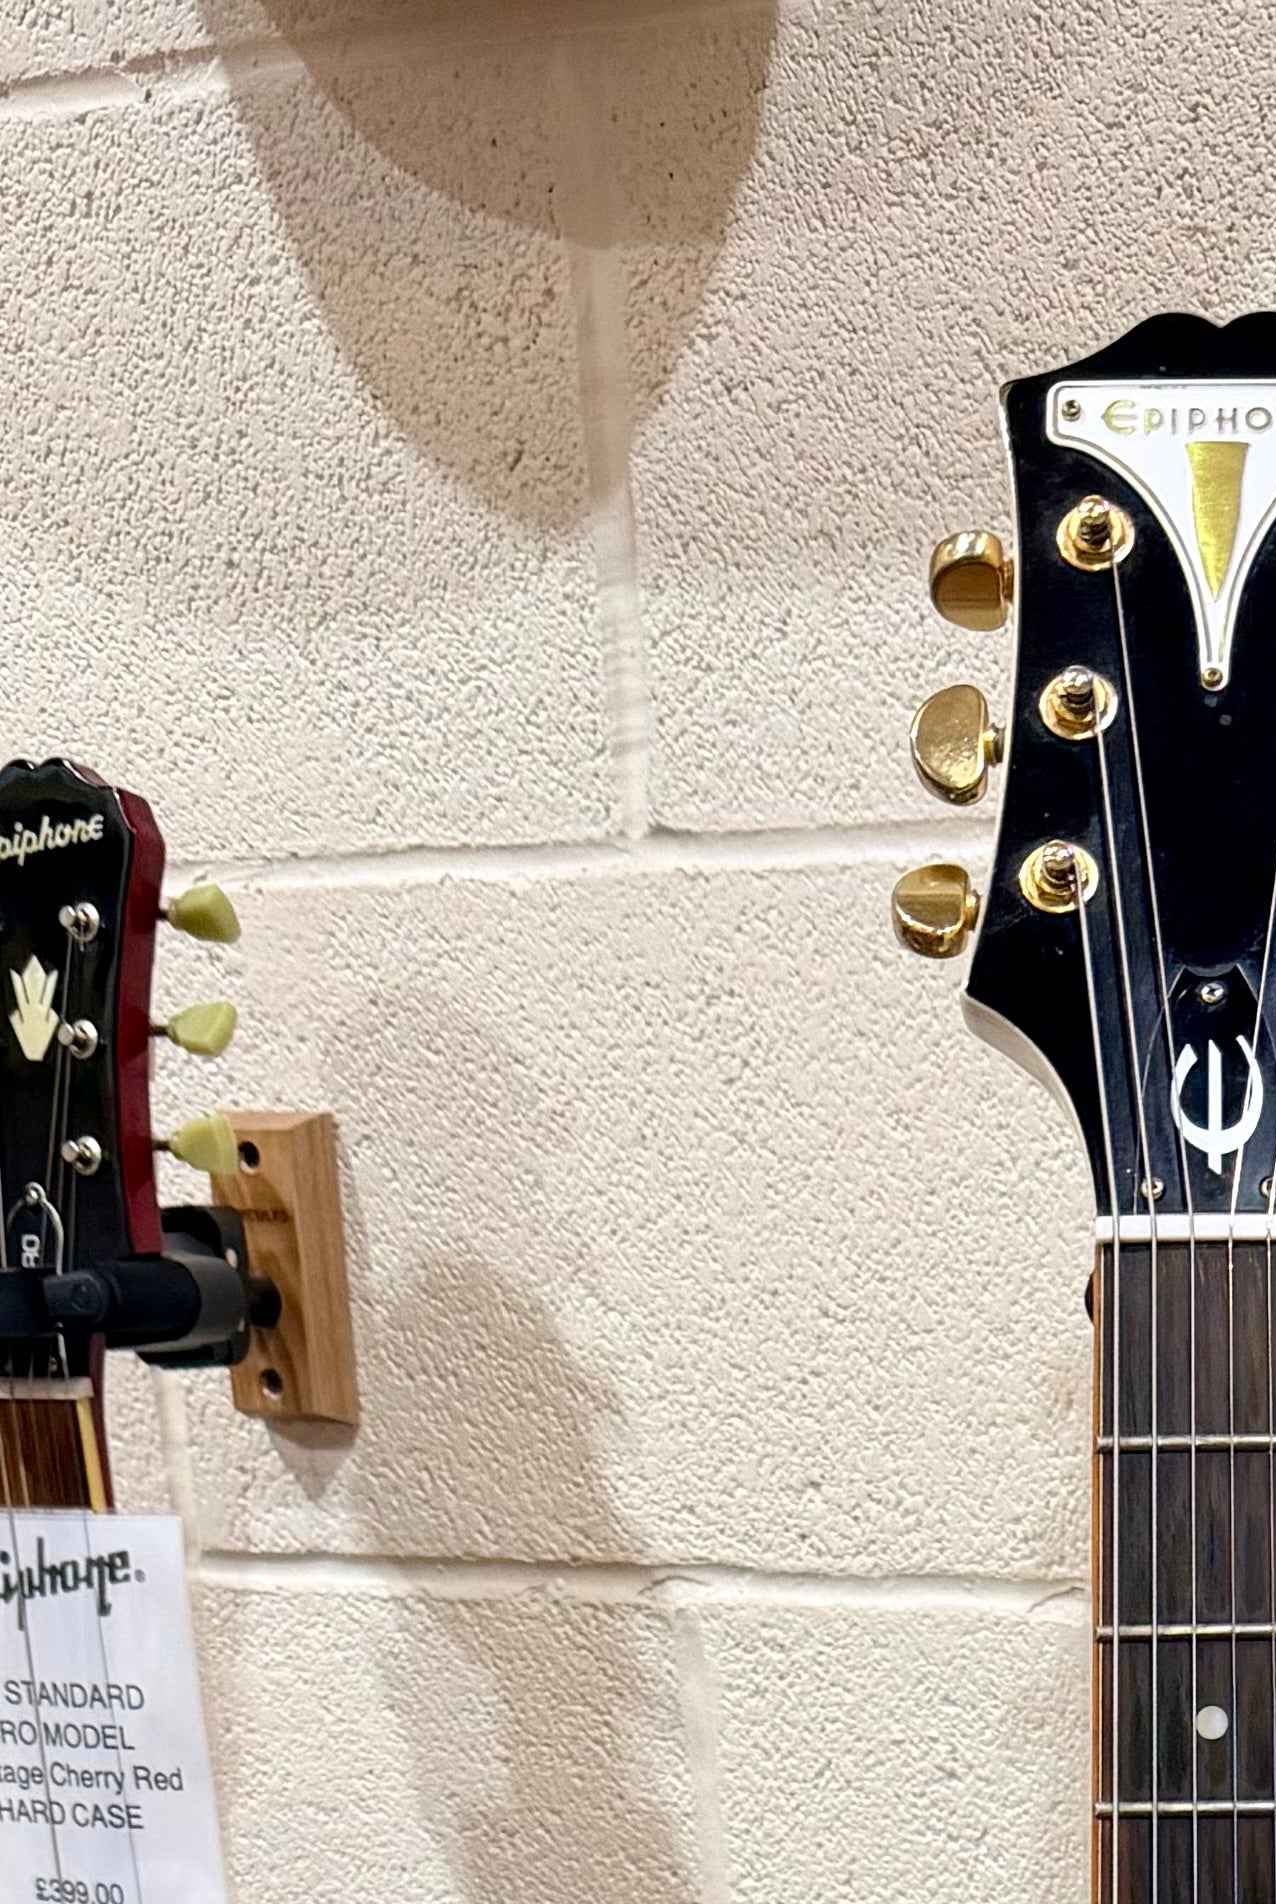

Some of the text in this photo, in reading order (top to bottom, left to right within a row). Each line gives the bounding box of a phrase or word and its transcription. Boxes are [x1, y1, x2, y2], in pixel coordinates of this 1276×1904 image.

[4, 1680, 145, 1711] STANDARD
[43, 1722, 135, 1750] MODEL
[50, 1761, 125, 1796] Cherry
[133, 1765, 185, 1792] Red
[72, 1802, 145, 1830] CASE
